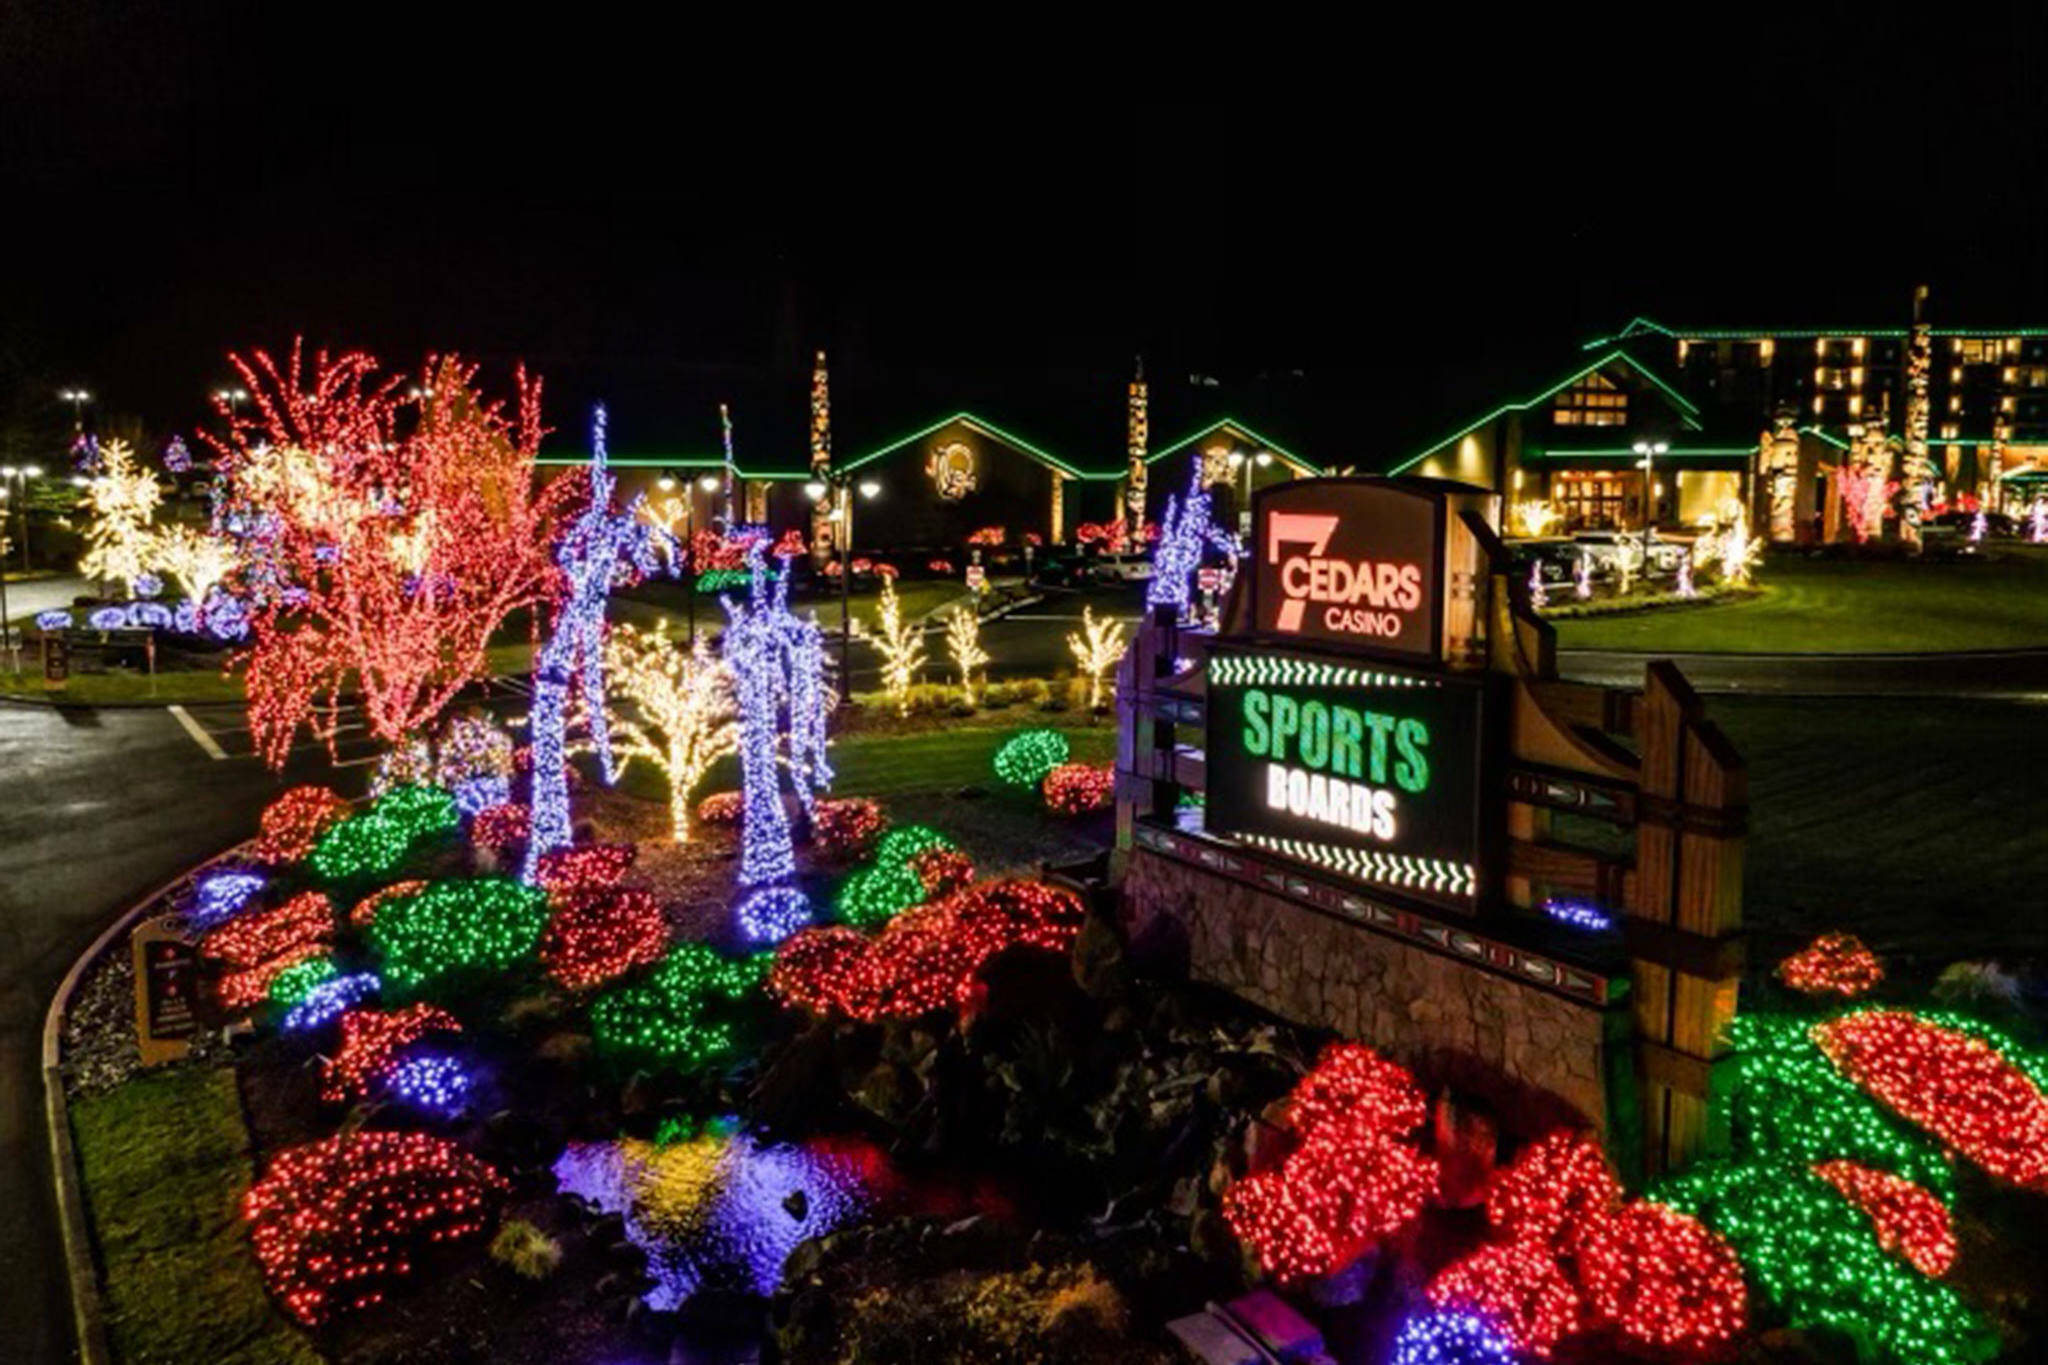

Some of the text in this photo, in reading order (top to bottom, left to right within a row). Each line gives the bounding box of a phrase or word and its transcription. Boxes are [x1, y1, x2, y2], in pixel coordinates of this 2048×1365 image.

[1269, 511, 1422, 632] 7 CEDARS
[1325, 607, 1401, 638] CASINO
[1243, 689, 1430, 793] SPORTS
[1267, 763, 1396, 842] BOARDS
